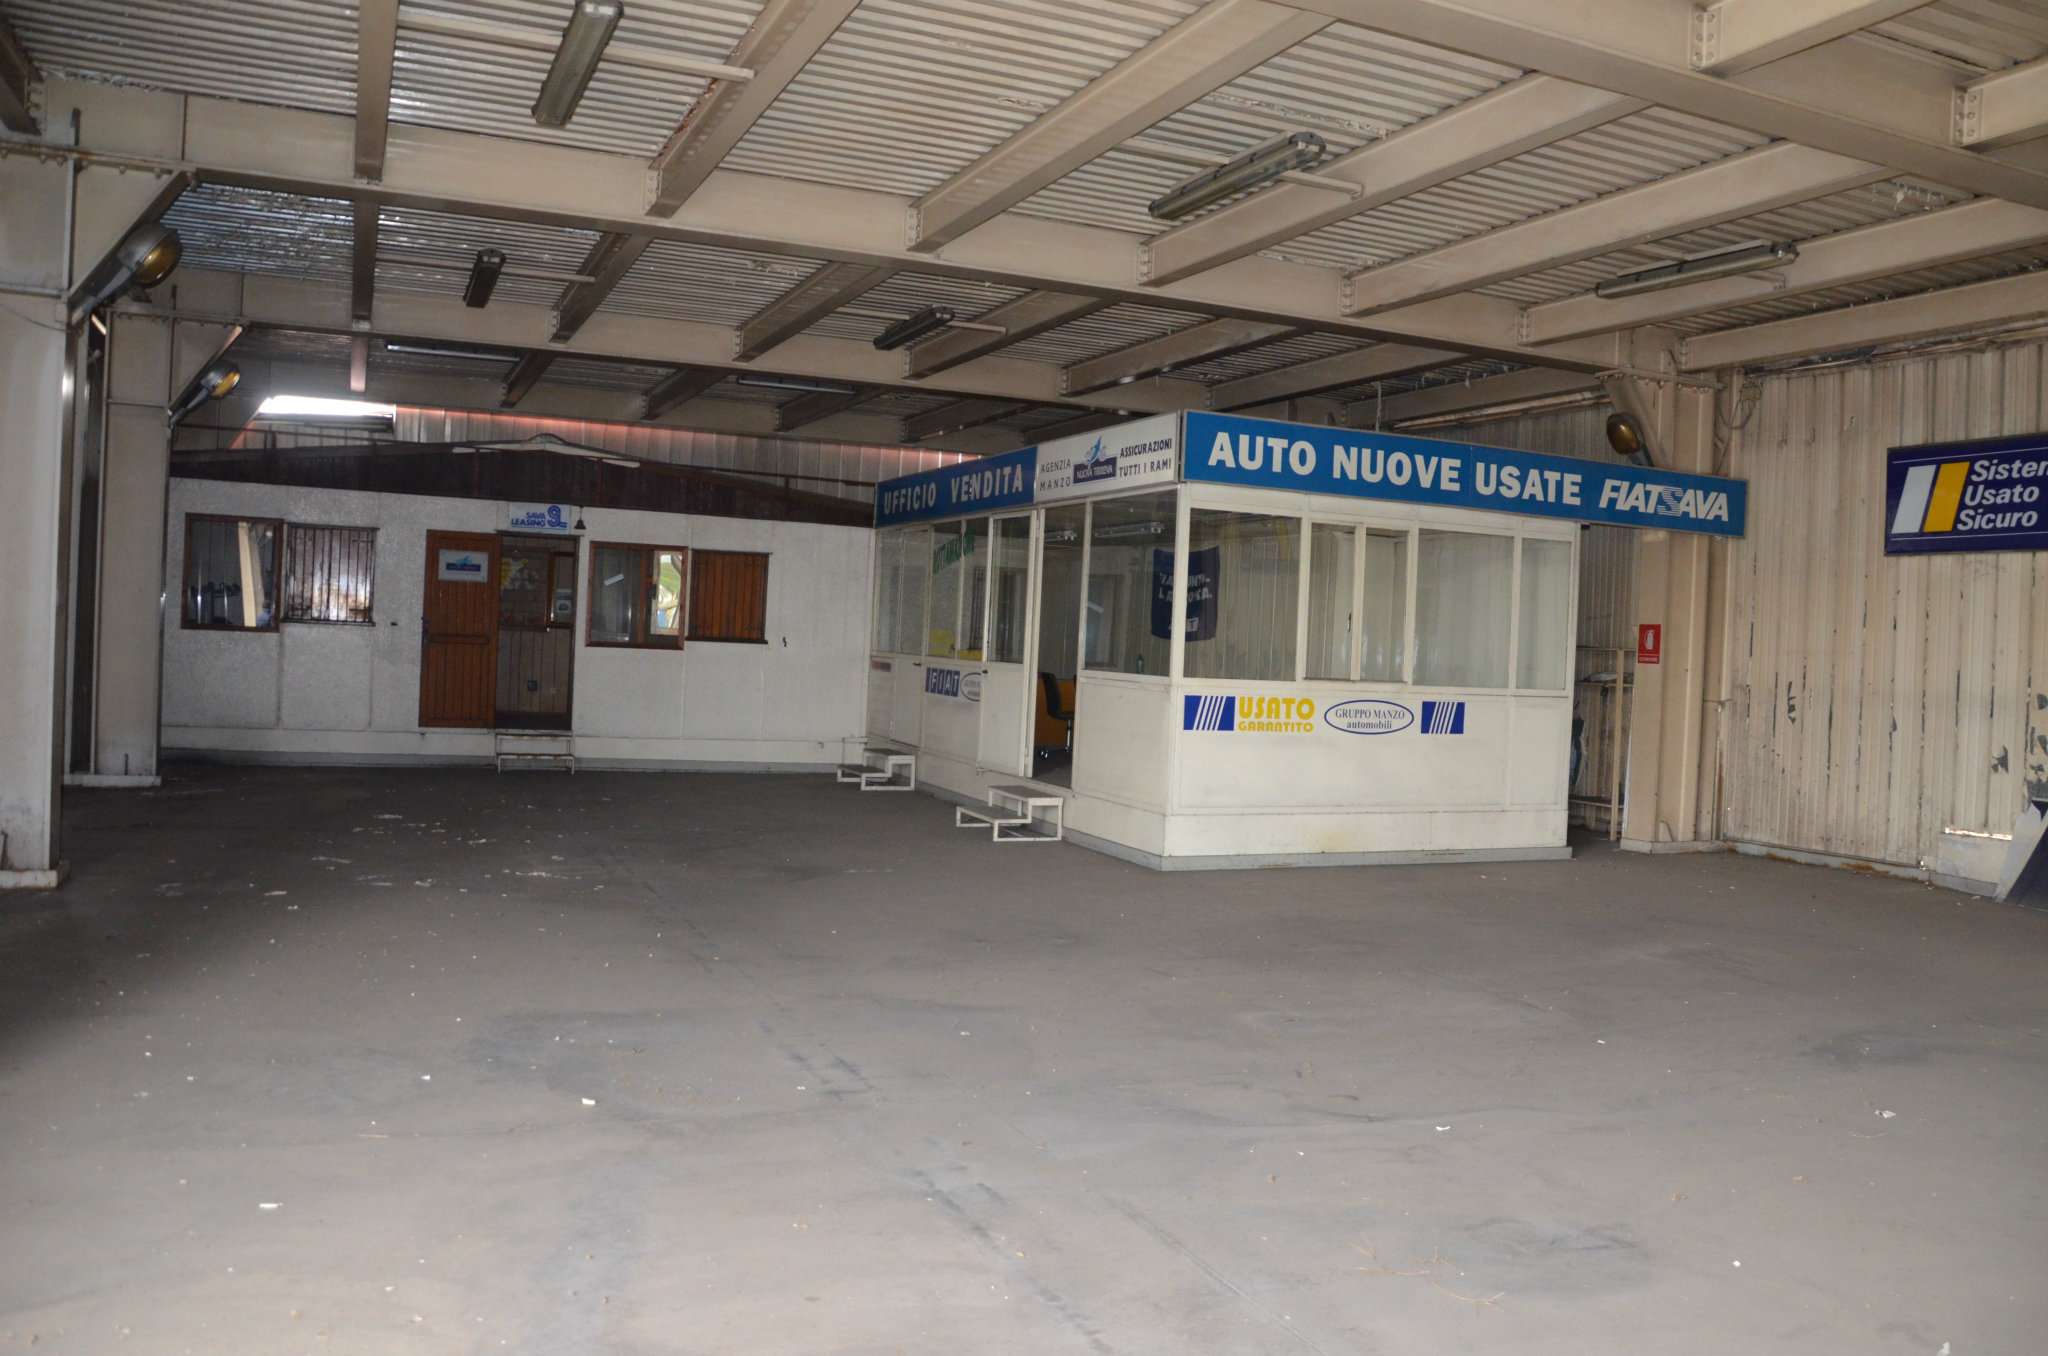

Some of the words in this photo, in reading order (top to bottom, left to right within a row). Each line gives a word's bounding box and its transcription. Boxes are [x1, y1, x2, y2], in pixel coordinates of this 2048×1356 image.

[1120, 438, 1172, 458] ASSICURAZIONI
[1041, 459, 1071, 473] AGENZIA
[1119, 463, 1141, 477] TUTTI
[1150, 459, 1172, 473] RAMI
[1207, 431, 1317, 476] AUTO
[1332, 444, 1462, 493] NUOVE
[1475, 461, 1583, 506] USATE
[884, 482, 937, 515] UFFICIO
[951, 463, 1023, 504] VENDITA
[1040, 477, 1071, 491] MANZO
[1964, 483, 2040, 507] Usato
[1956, 508, 2038, 531] Sicuro
[930, 669, 960, 695] FIAT
[1238, 696, 1316, 721] USATO
[1335, 708, 1371, 720] GRUPPO
[1373, 709, 1405, 720] MANZO
[1238, 721, 1314, 733] GARANTITO
[1346, 720, 1393, 730] automobili
